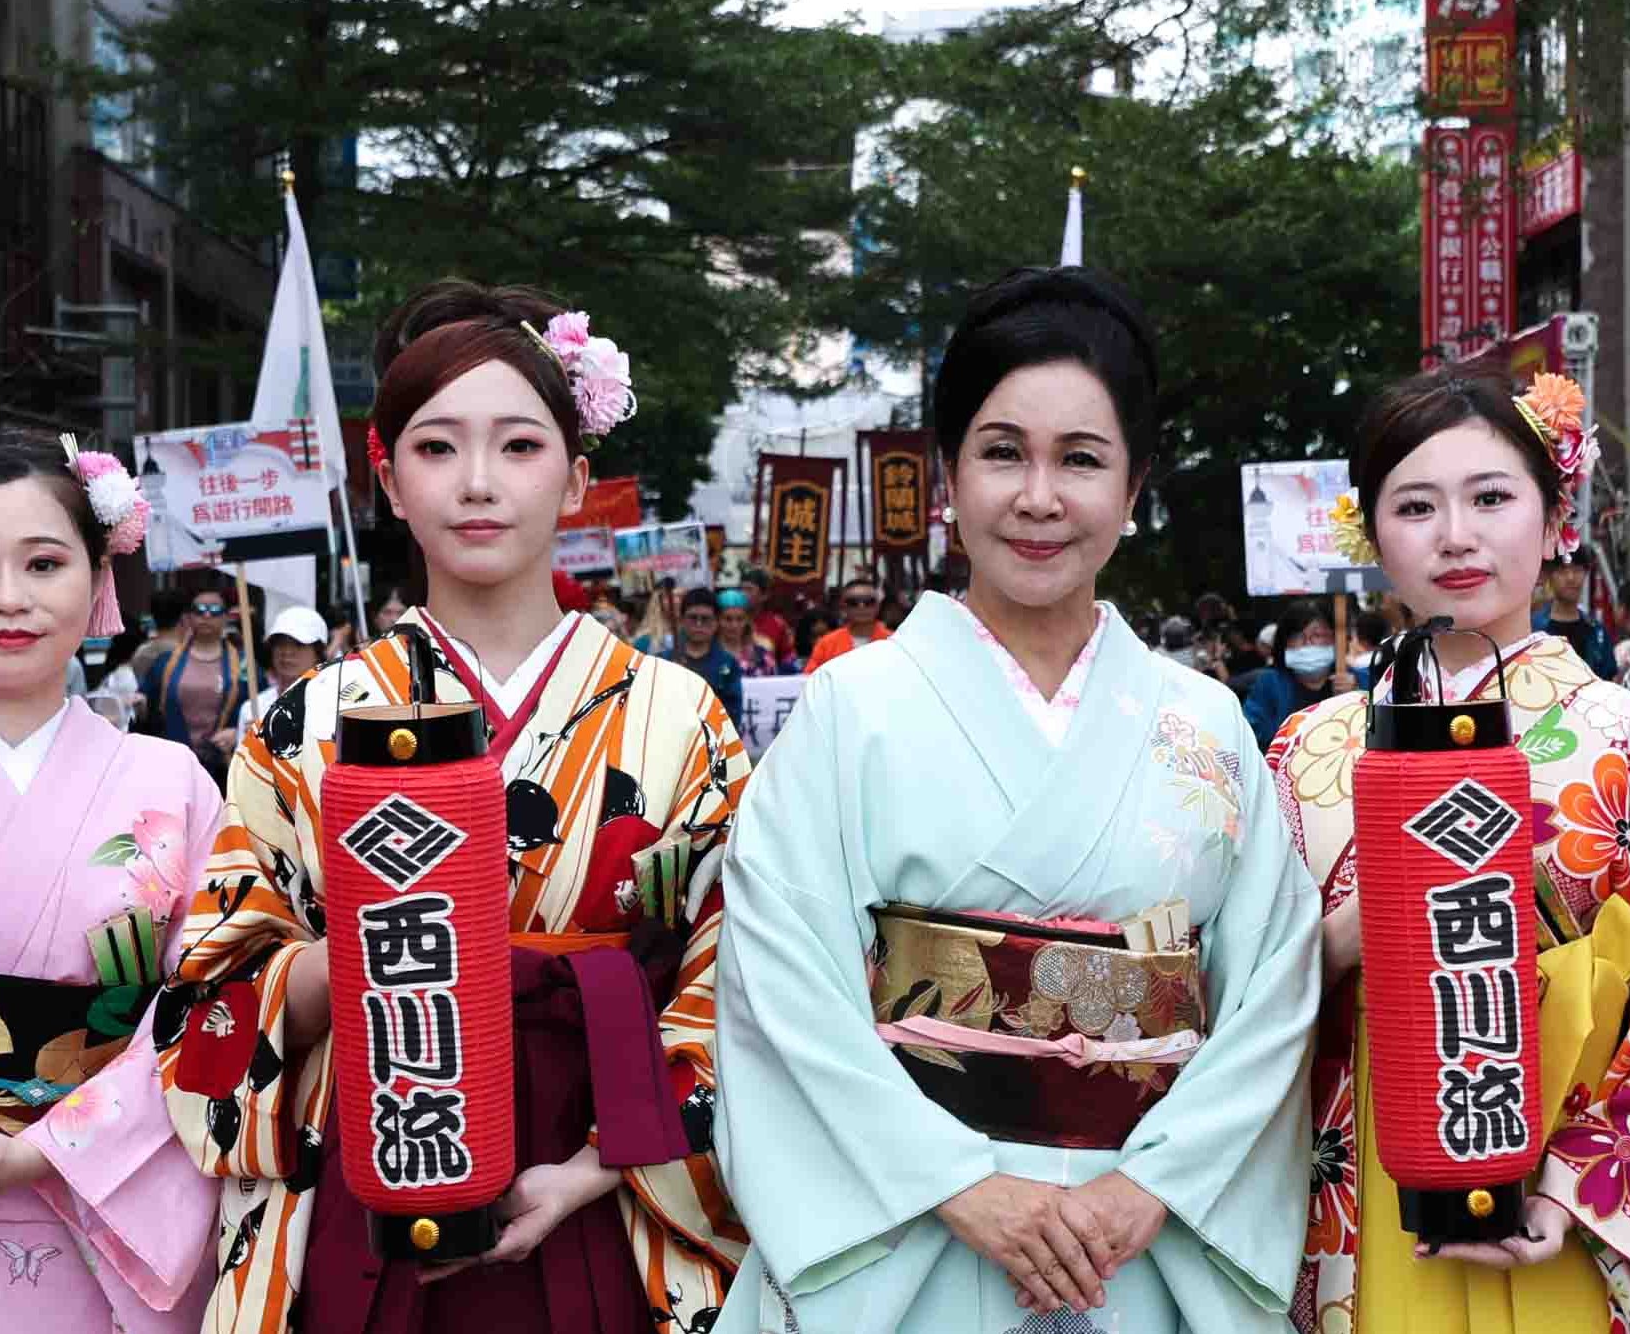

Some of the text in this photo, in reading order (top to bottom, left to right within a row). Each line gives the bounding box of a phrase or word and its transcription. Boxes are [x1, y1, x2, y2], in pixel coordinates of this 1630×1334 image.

[357, 891, 473, 1190] 西川流
[1425, 870, 1529, 1162] 西川流
